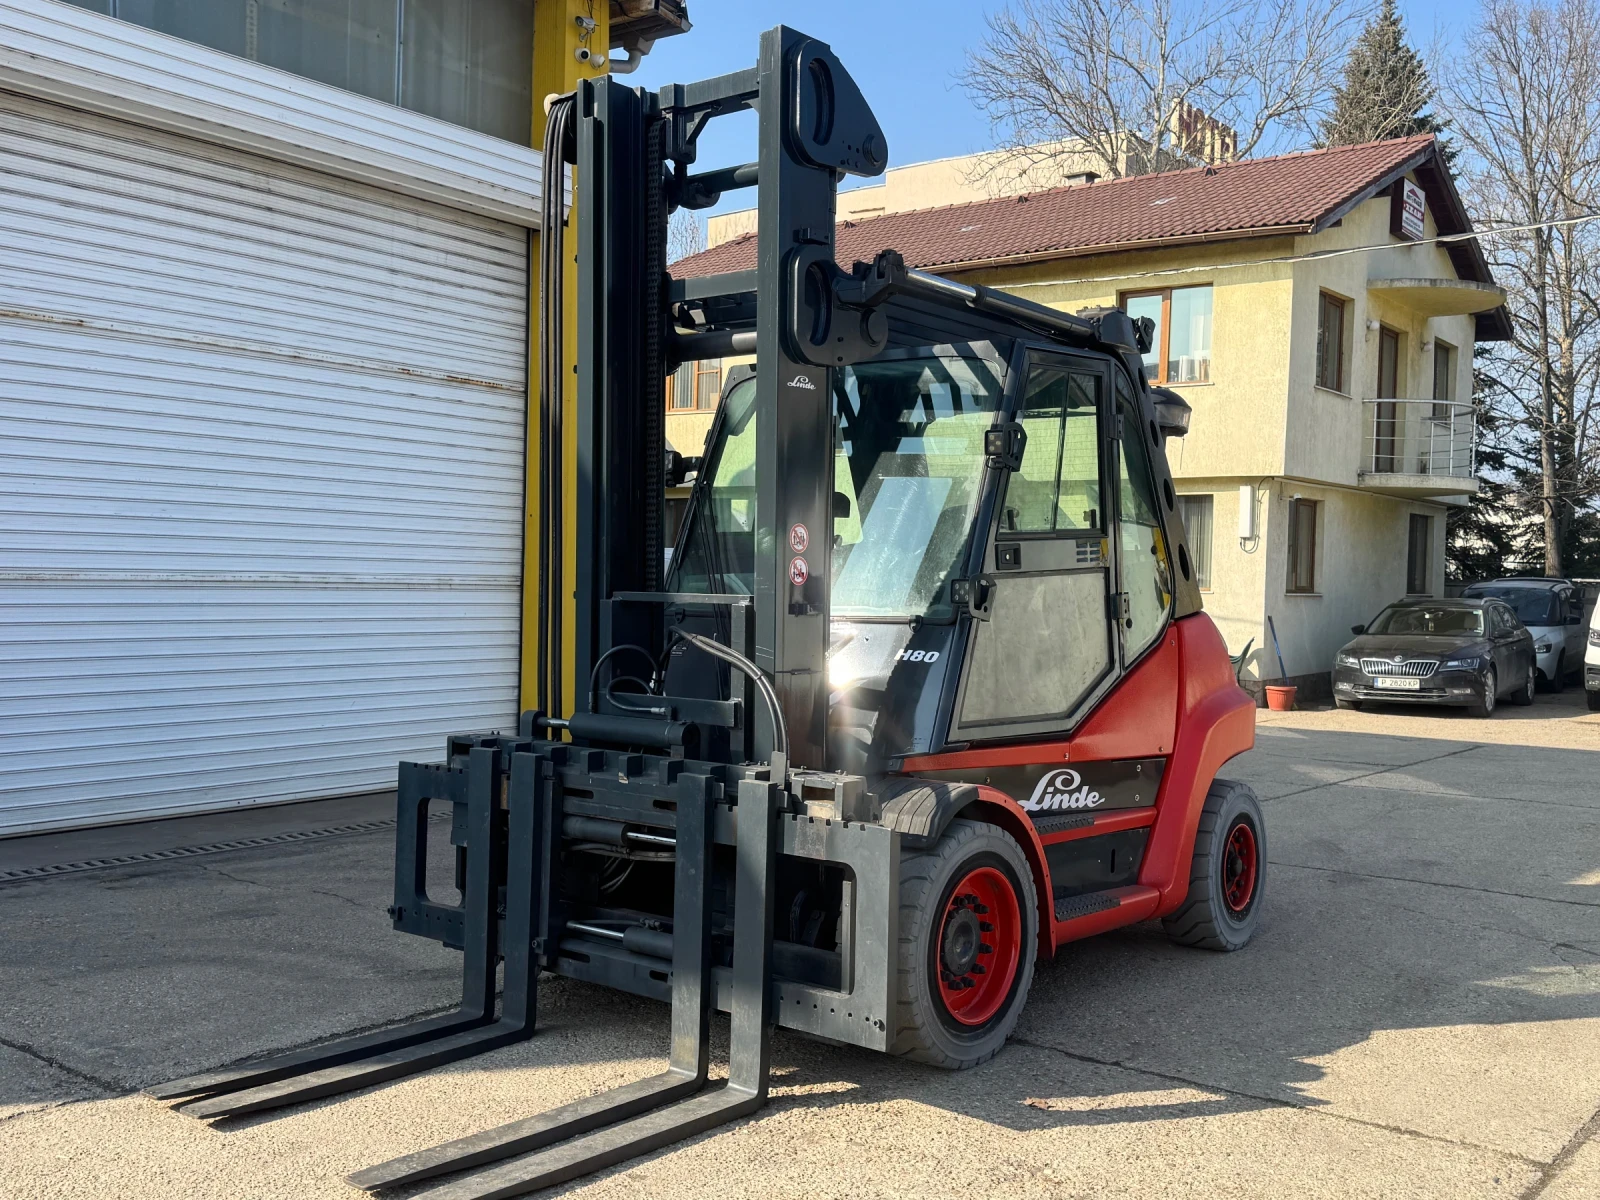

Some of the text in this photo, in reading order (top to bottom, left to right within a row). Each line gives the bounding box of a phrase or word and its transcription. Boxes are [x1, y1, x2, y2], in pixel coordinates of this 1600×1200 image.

[787, 375, 816, 390] Linde
[894, 649, 940, 663] H80
[1017, 768, 1106, 812] Linde
